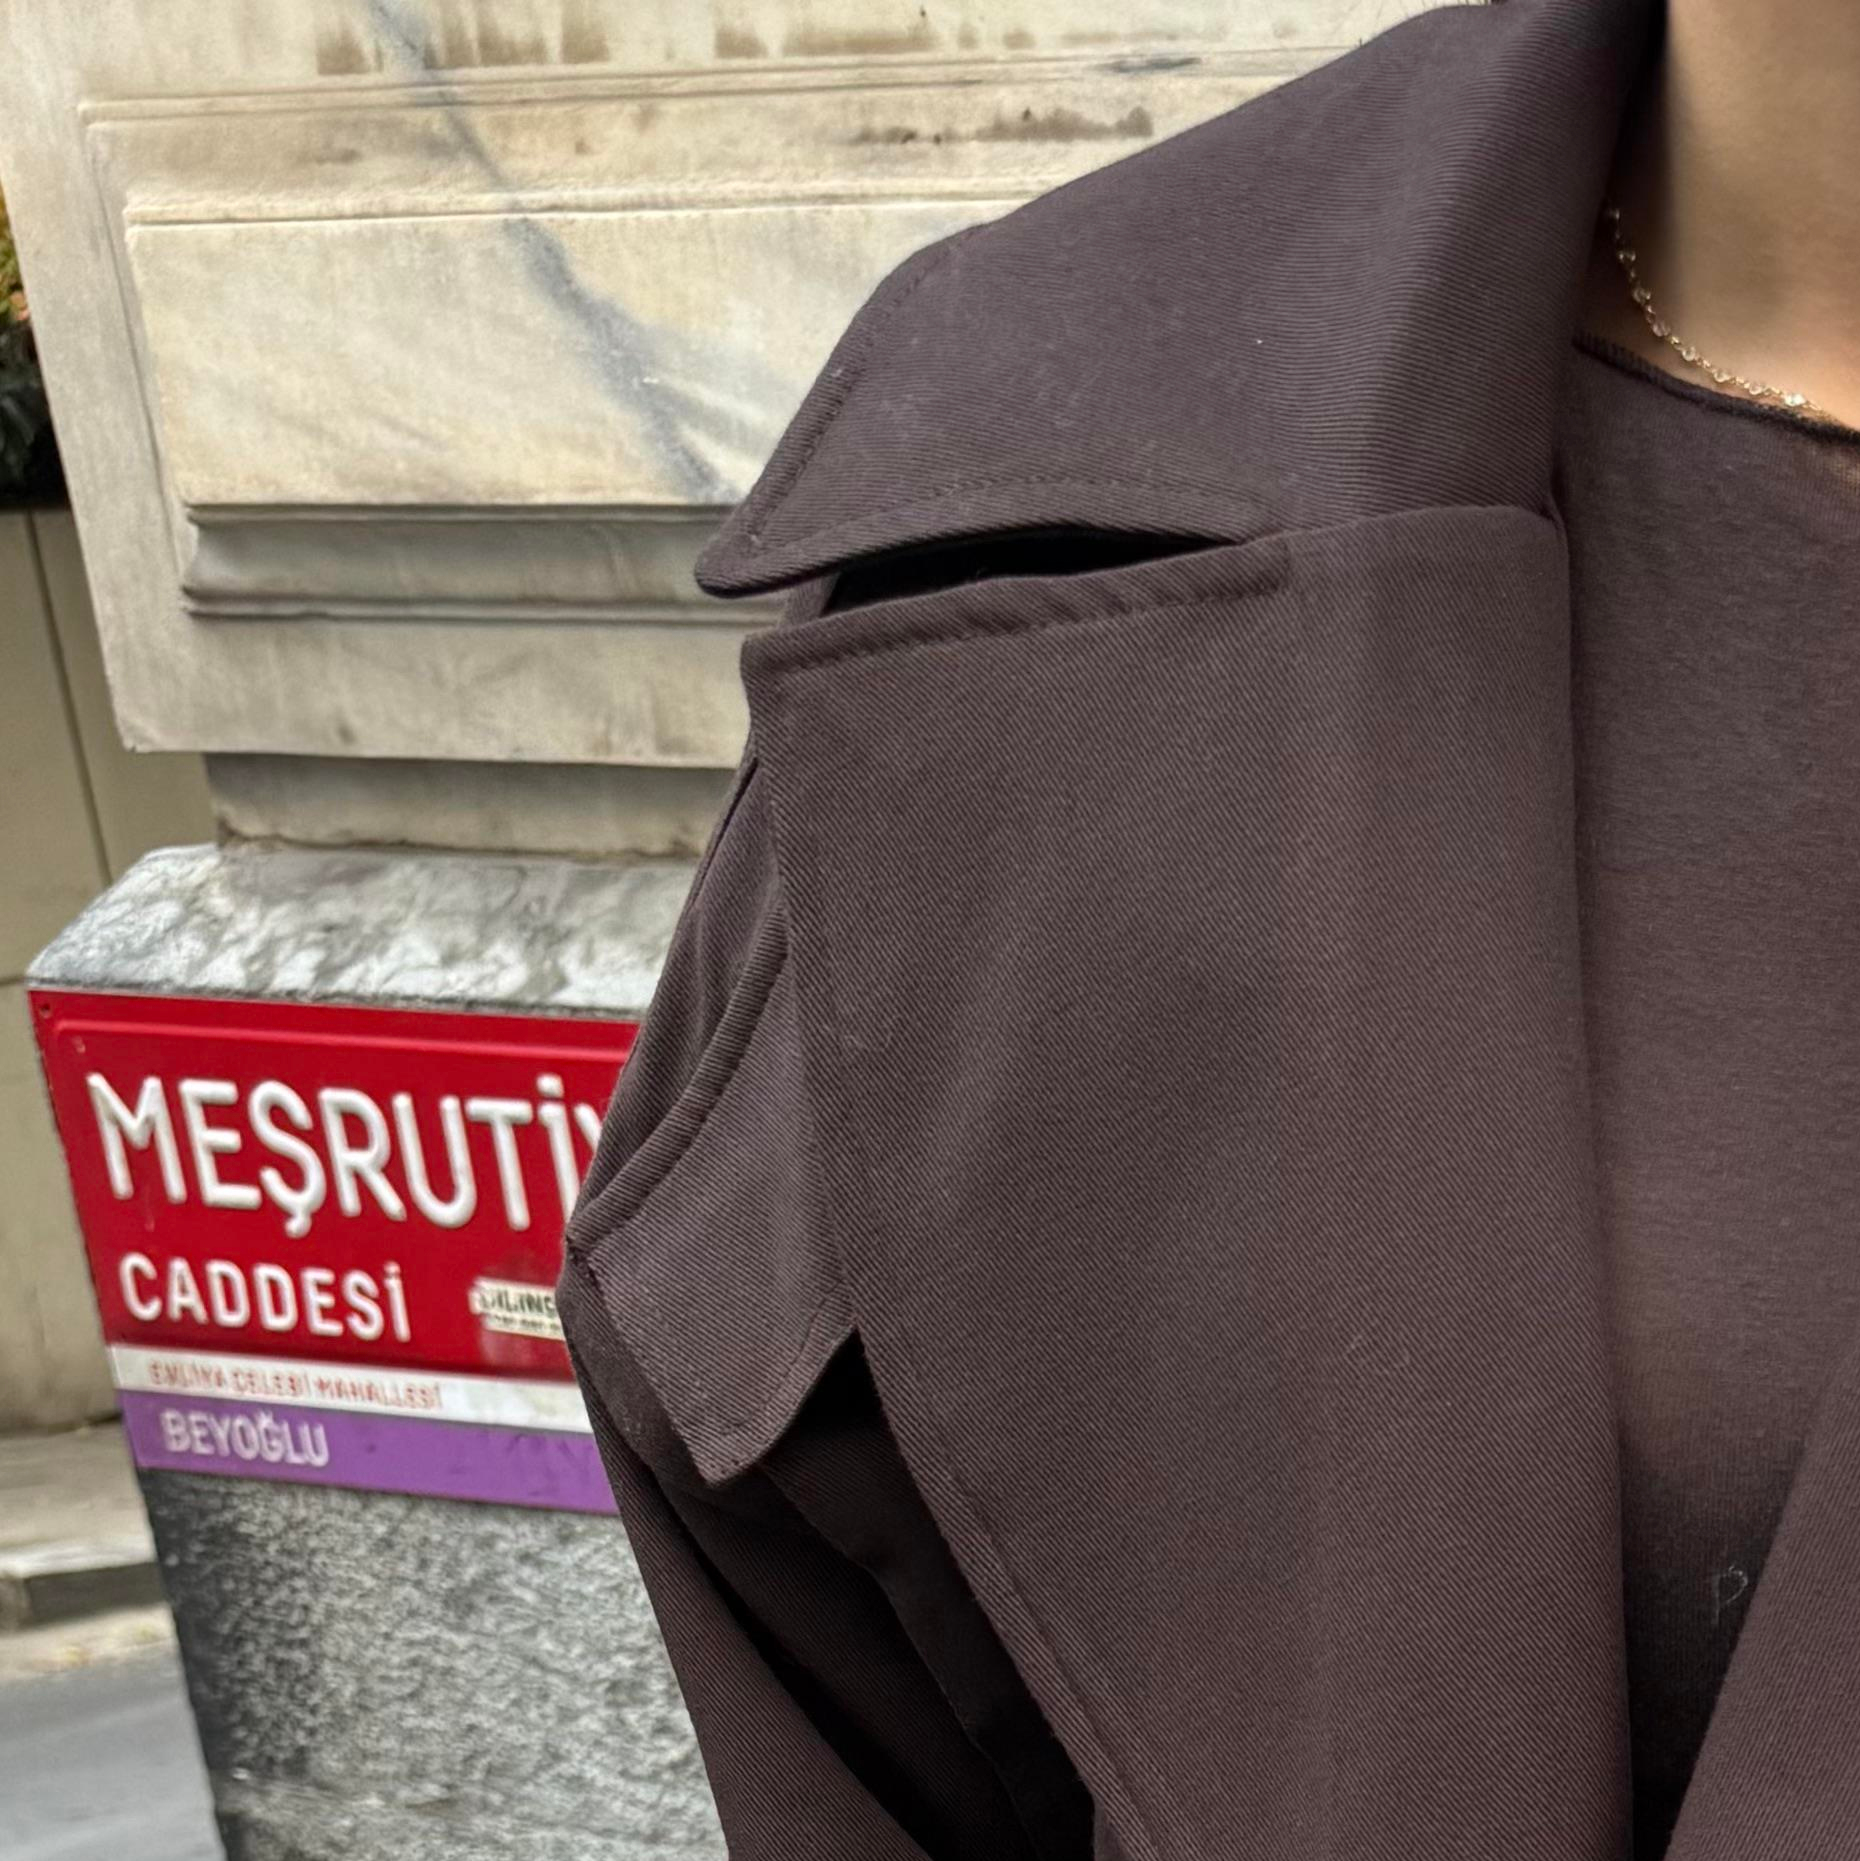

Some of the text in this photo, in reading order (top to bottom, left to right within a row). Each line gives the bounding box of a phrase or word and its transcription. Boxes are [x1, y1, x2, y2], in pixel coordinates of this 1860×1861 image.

[86, 1072, 602, 1238] MEŞRUTİ
[119, 1252, 411, 1343] CADDESİ
[161, 1408, 331, 1469] BEYOĞLU
